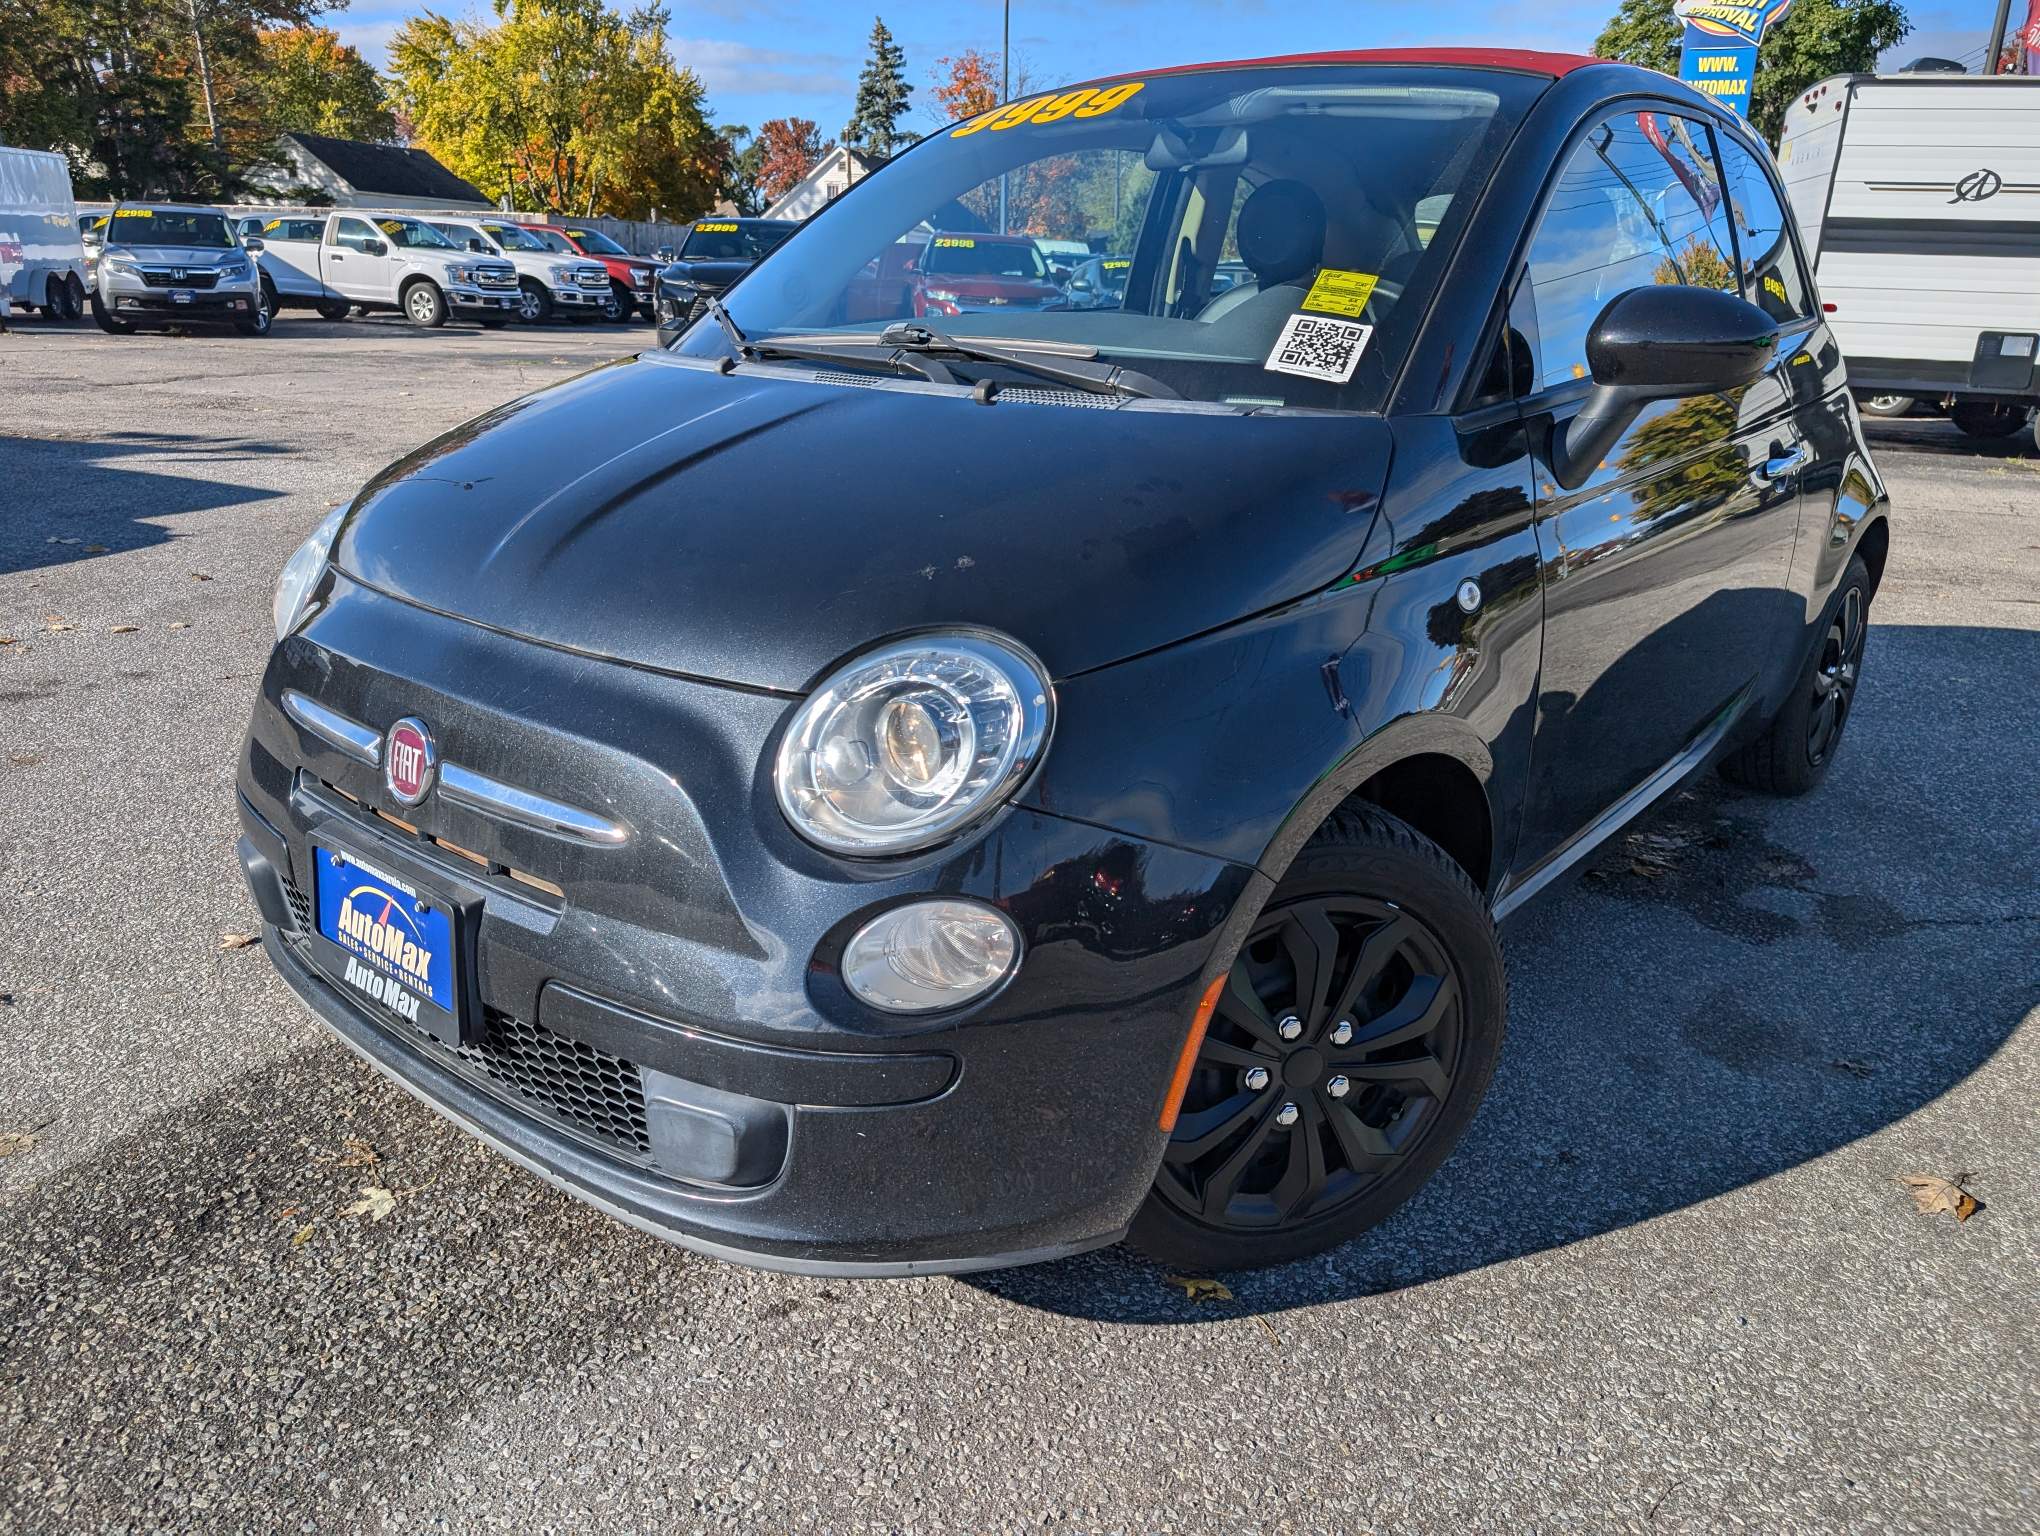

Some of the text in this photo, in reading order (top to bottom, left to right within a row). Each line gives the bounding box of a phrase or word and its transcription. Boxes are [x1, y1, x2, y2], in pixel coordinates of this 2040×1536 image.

[1687, 7, 1759, 32] APPROVAL
[1698, 56, 1739, 72] WWW.
[950, 82, 1145, 138] 9999
[393, 740, 423, 785] FIAT
[338, 896, 432, 981] AutoMax
[338, 930, 433, 998] SALES SERVICE RENTALS
